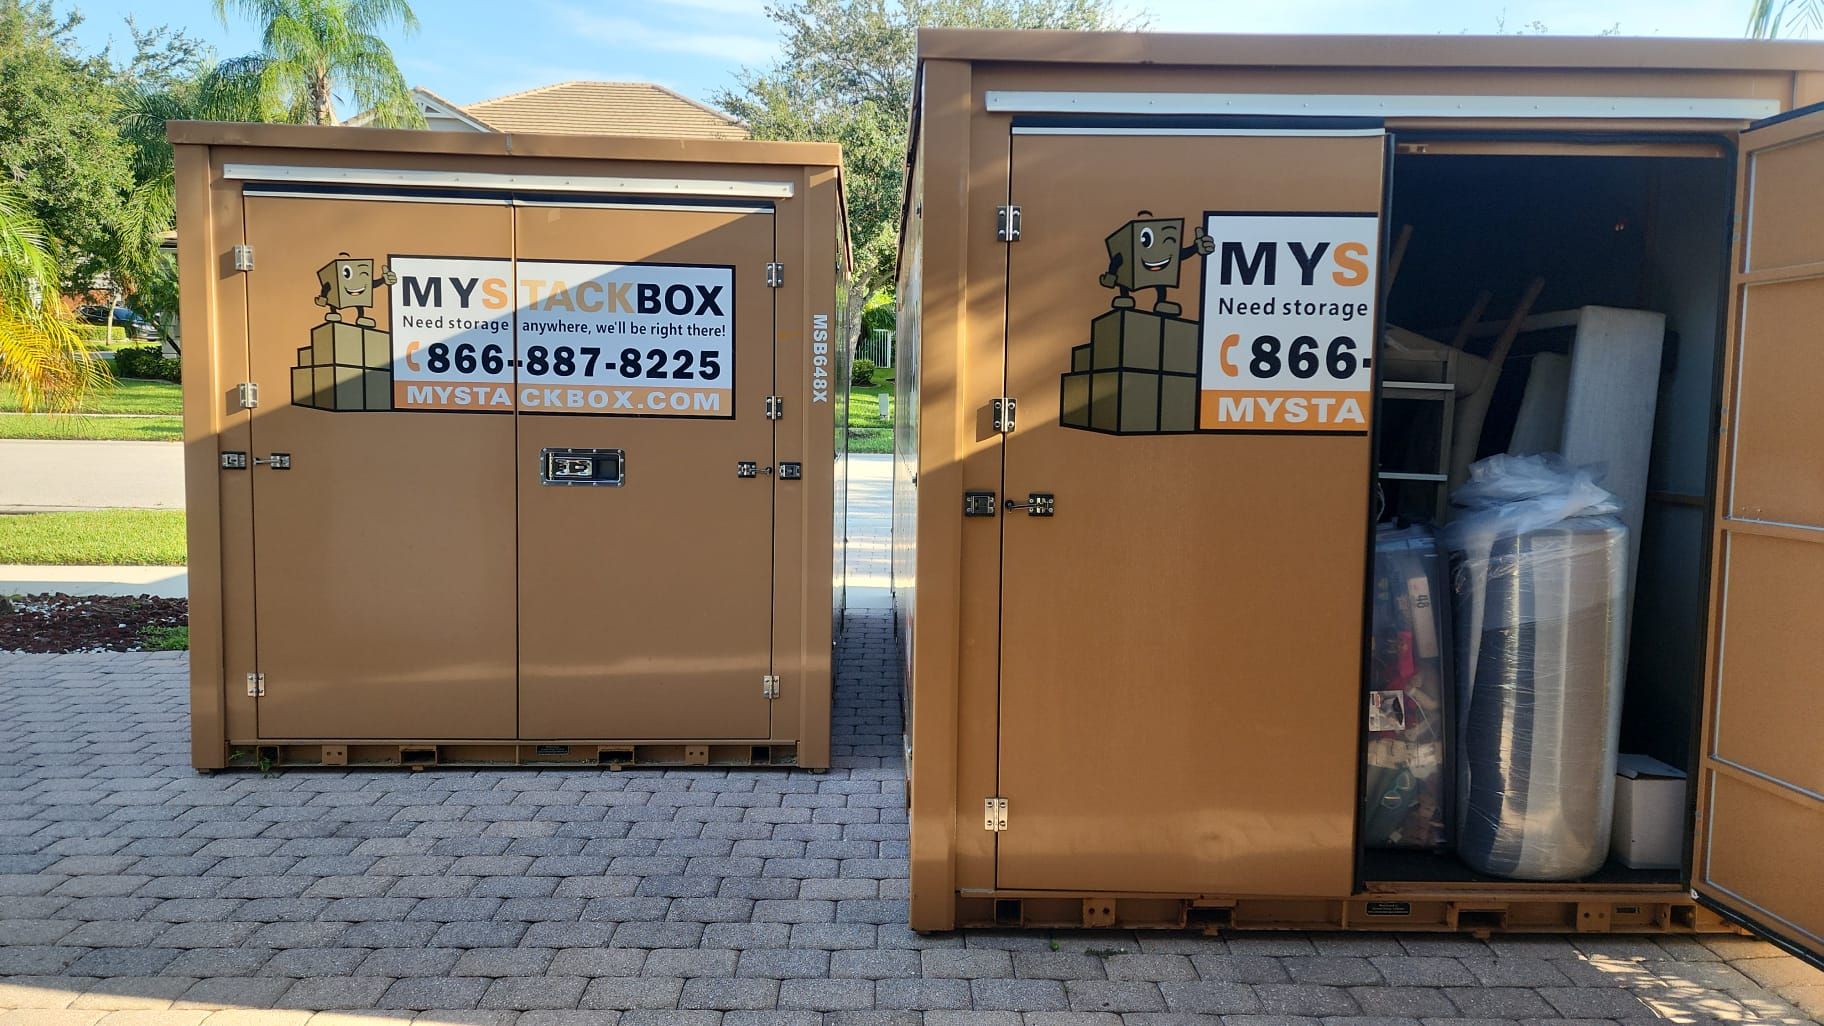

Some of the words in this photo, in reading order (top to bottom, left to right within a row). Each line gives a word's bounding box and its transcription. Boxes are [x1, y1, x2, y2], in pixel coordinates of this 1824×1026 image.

[1220, 241, 1369, 286] MYS
[1218, 297, 1276, 315] Need
[1282, 300, 1368, 321] storage
[402, 315, 444, 330] Need
[448, 318, 509, 335] storage
[522, 321, 592, 336] anywhere,
[595, 322, 627, 336] we'll
[630, 323, 647, 337] be
[650, 323, 683, 339] right
[687, 325, 726, 337] there!
[813, 314, 828, 403] MSB648X
[406, 386, 721, 411] MYSTACKBOX.COM
[1218, 397, 1365, 423] MYSTA
